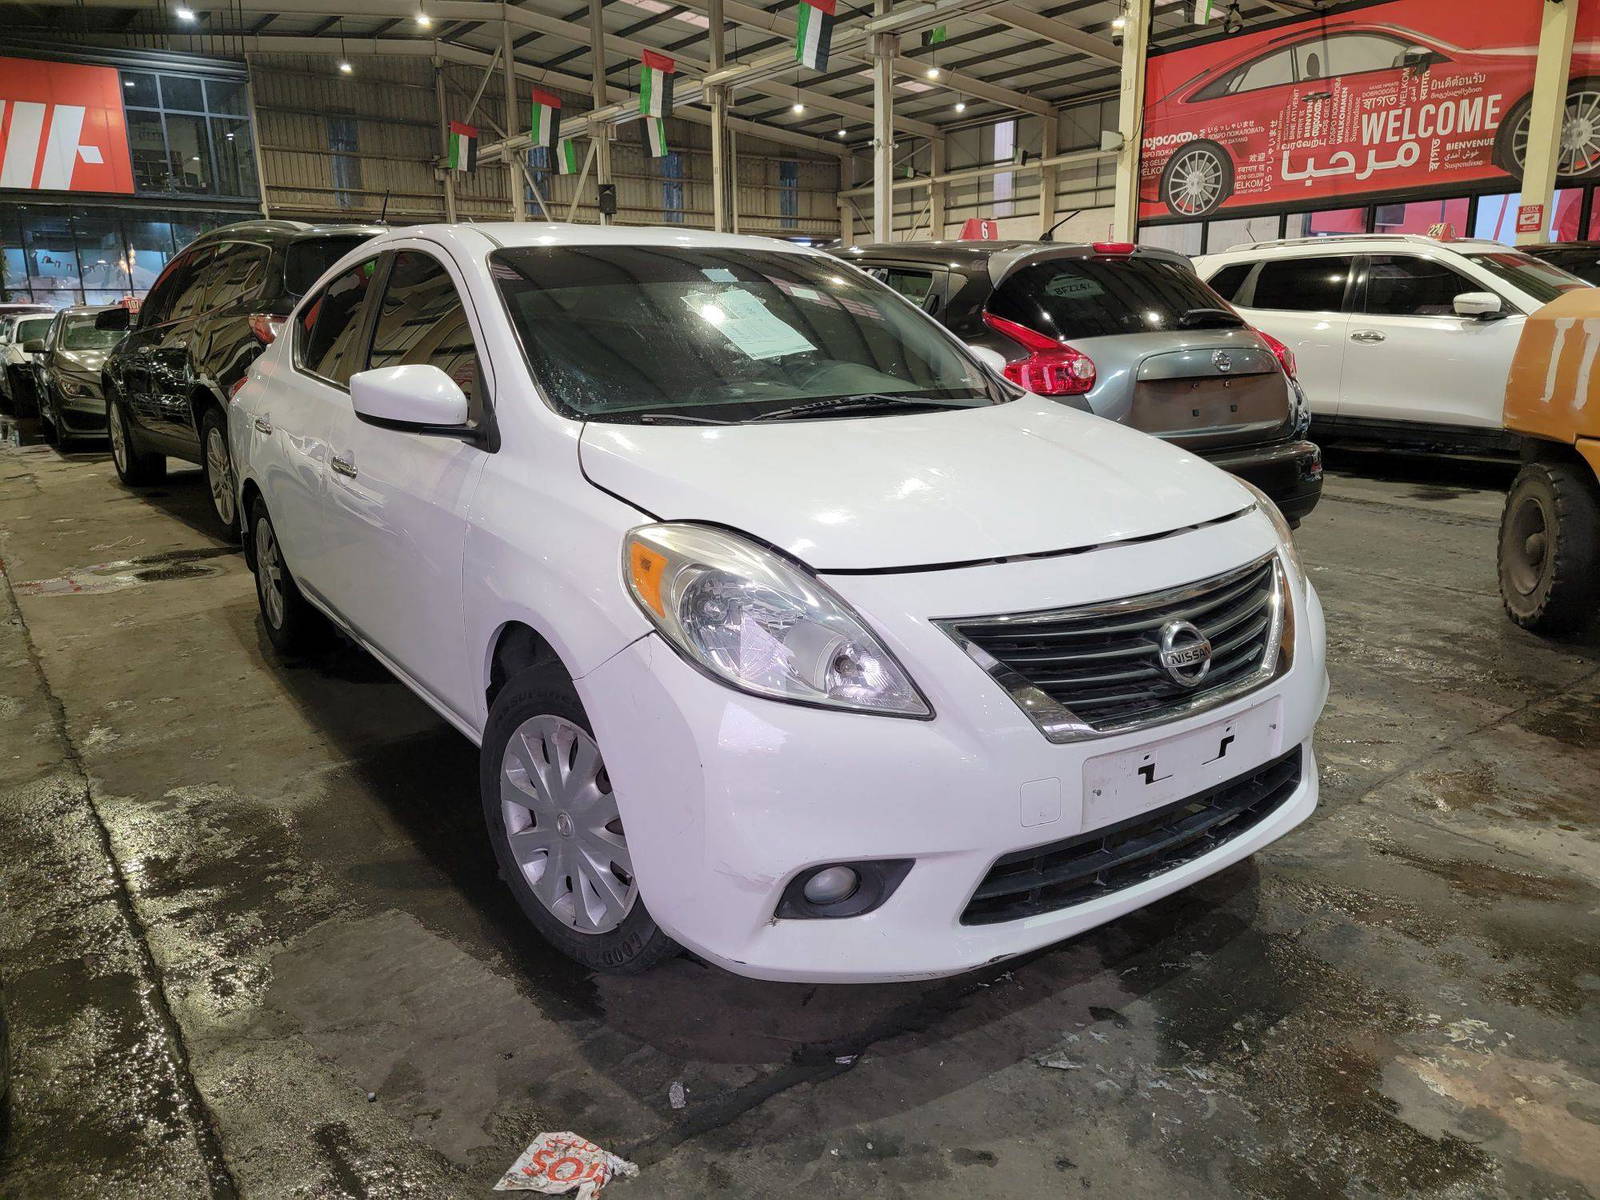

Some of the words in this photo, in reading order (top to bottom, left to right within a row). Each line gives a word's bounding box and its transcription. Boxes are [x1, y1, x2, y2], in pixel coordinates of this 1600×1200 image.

[1337, 87, 1348, 145] WILLKOMMEN
[1362, 94, 1502, 146] WELCOME
[1446, 138, 1495, 151] BIENVENUE
[1281, 142, 1420, 186] مرحبا
[980, 221, 989, 239] 6
[1170, 646, 1210, 664] NISSAN
